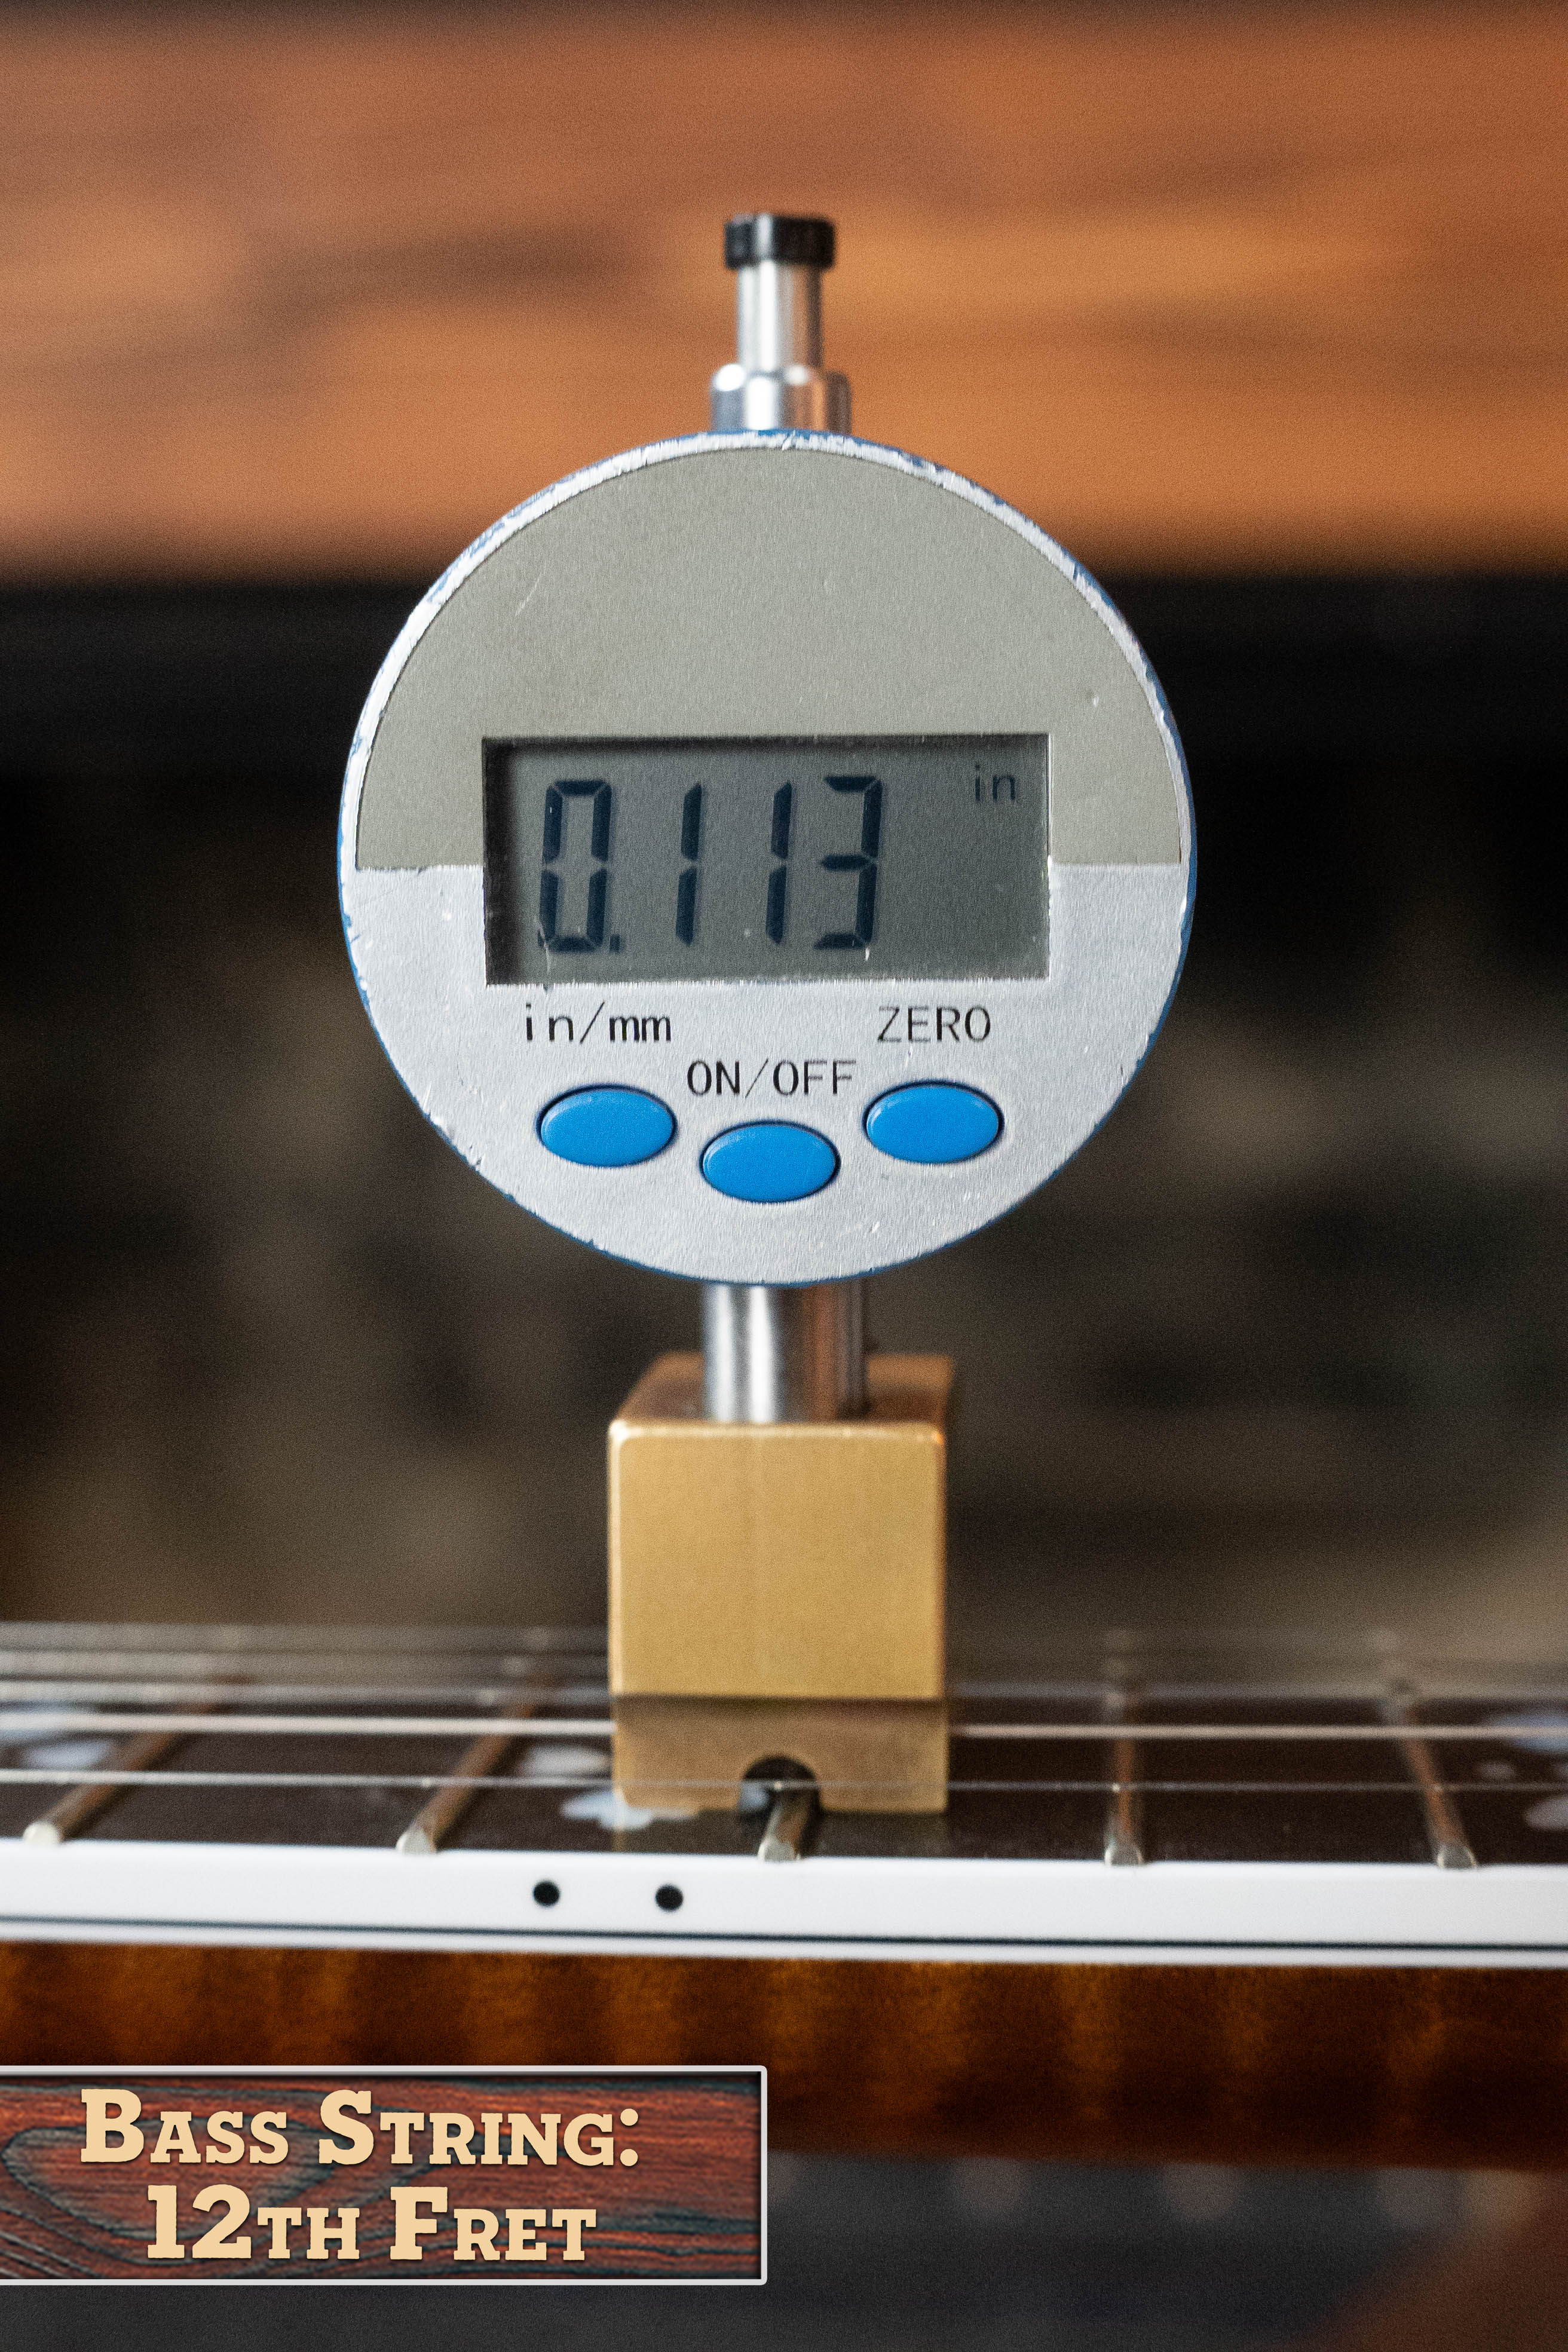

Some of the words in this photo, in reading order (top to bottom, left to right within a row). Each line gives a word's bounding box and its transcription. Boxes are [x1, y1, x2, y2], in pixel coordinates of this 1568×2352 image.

[973, 764, 1017, 804] in
[537, 776, 883, 953] 0.113
[525, 1002, 672, 1044] in/mm
[877, 1005, 992, 1044] ZERO
[687, 1058, 857, 1098] ON/OFF
